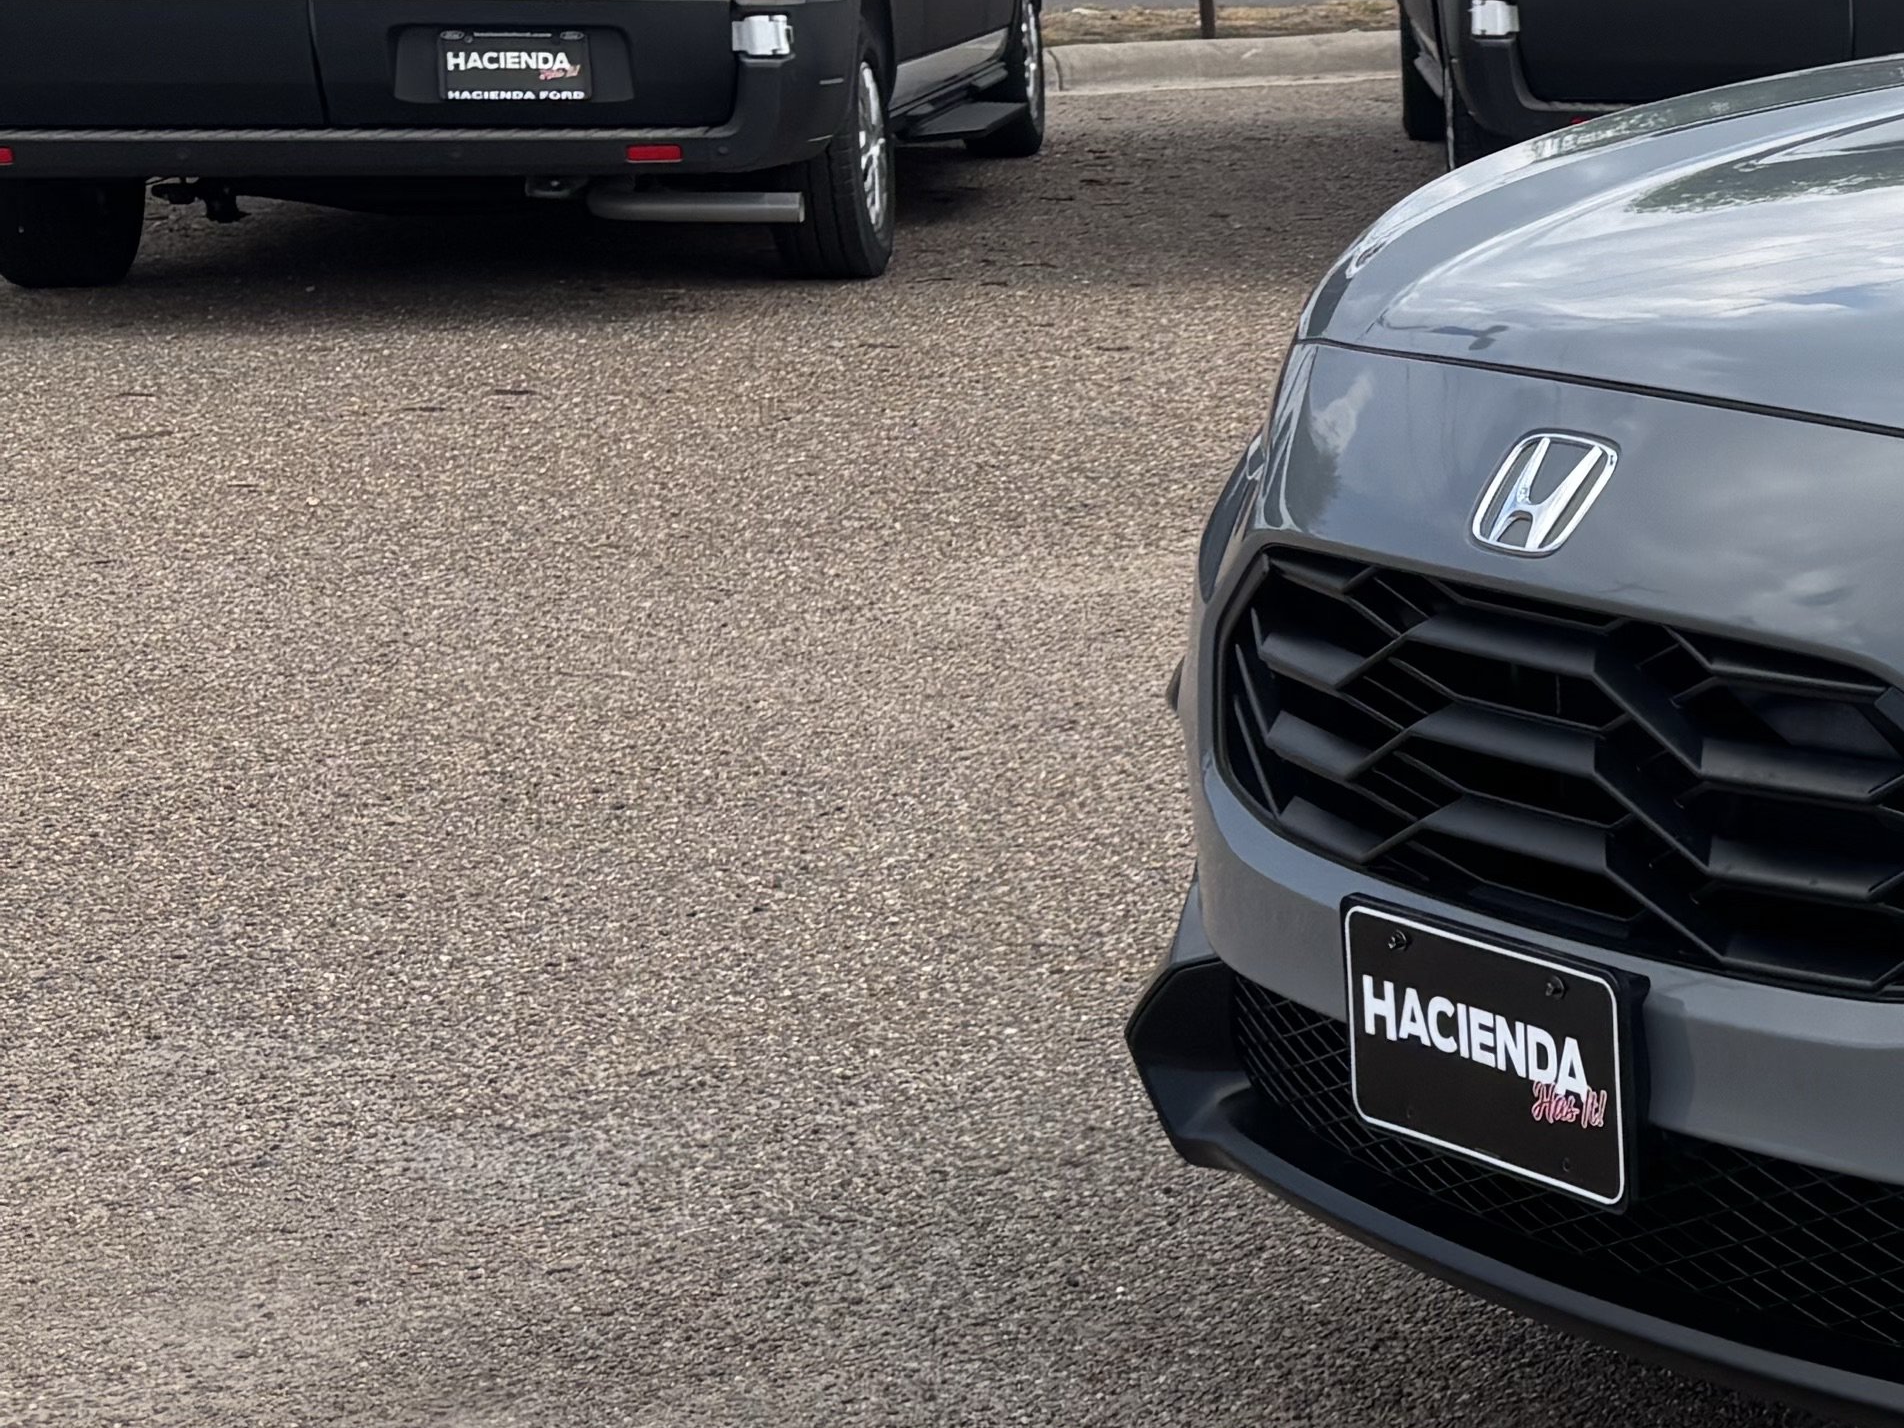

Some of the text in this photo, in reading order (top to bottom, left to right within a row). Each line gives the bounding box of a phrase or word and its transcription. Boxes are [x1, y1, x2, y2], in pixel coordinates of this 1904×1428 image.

[446, 51, 571, 70] HACIENDA
[448, 90, 585, 100] HACIENDA FORD
[1362, 974, 1588, 1105] HACIENDA
[1531, 1081, 1580, 1124] Has
